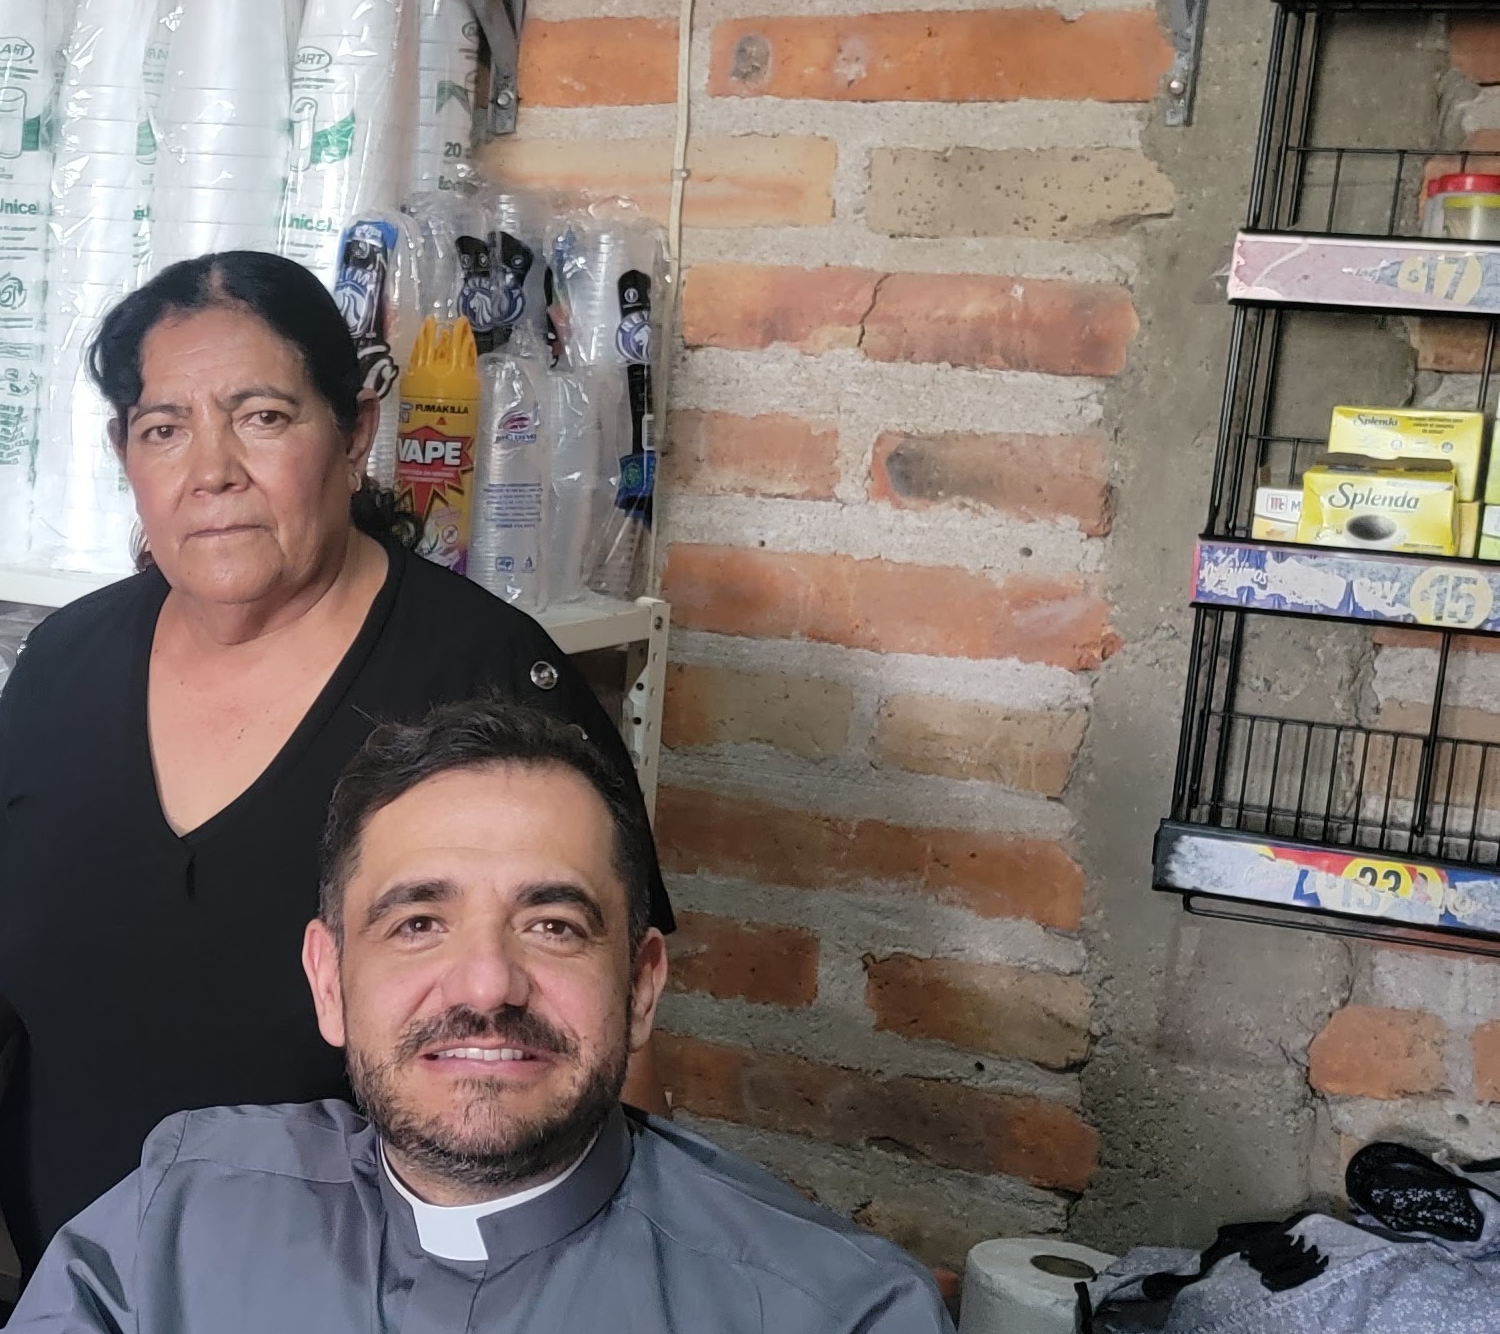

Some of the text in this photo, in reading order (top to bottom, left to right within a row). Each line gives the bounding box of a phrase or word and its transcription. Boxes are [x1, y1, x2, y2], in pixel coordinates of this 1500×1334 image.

[443, 141, 462, 158] 20
[290, 214, 332, 233] nicel
[1353, 413, 1398, 427] Splenda
[397, 438, 463, 466] VAPE
[1328, 481, 1421, 511] Splenda
